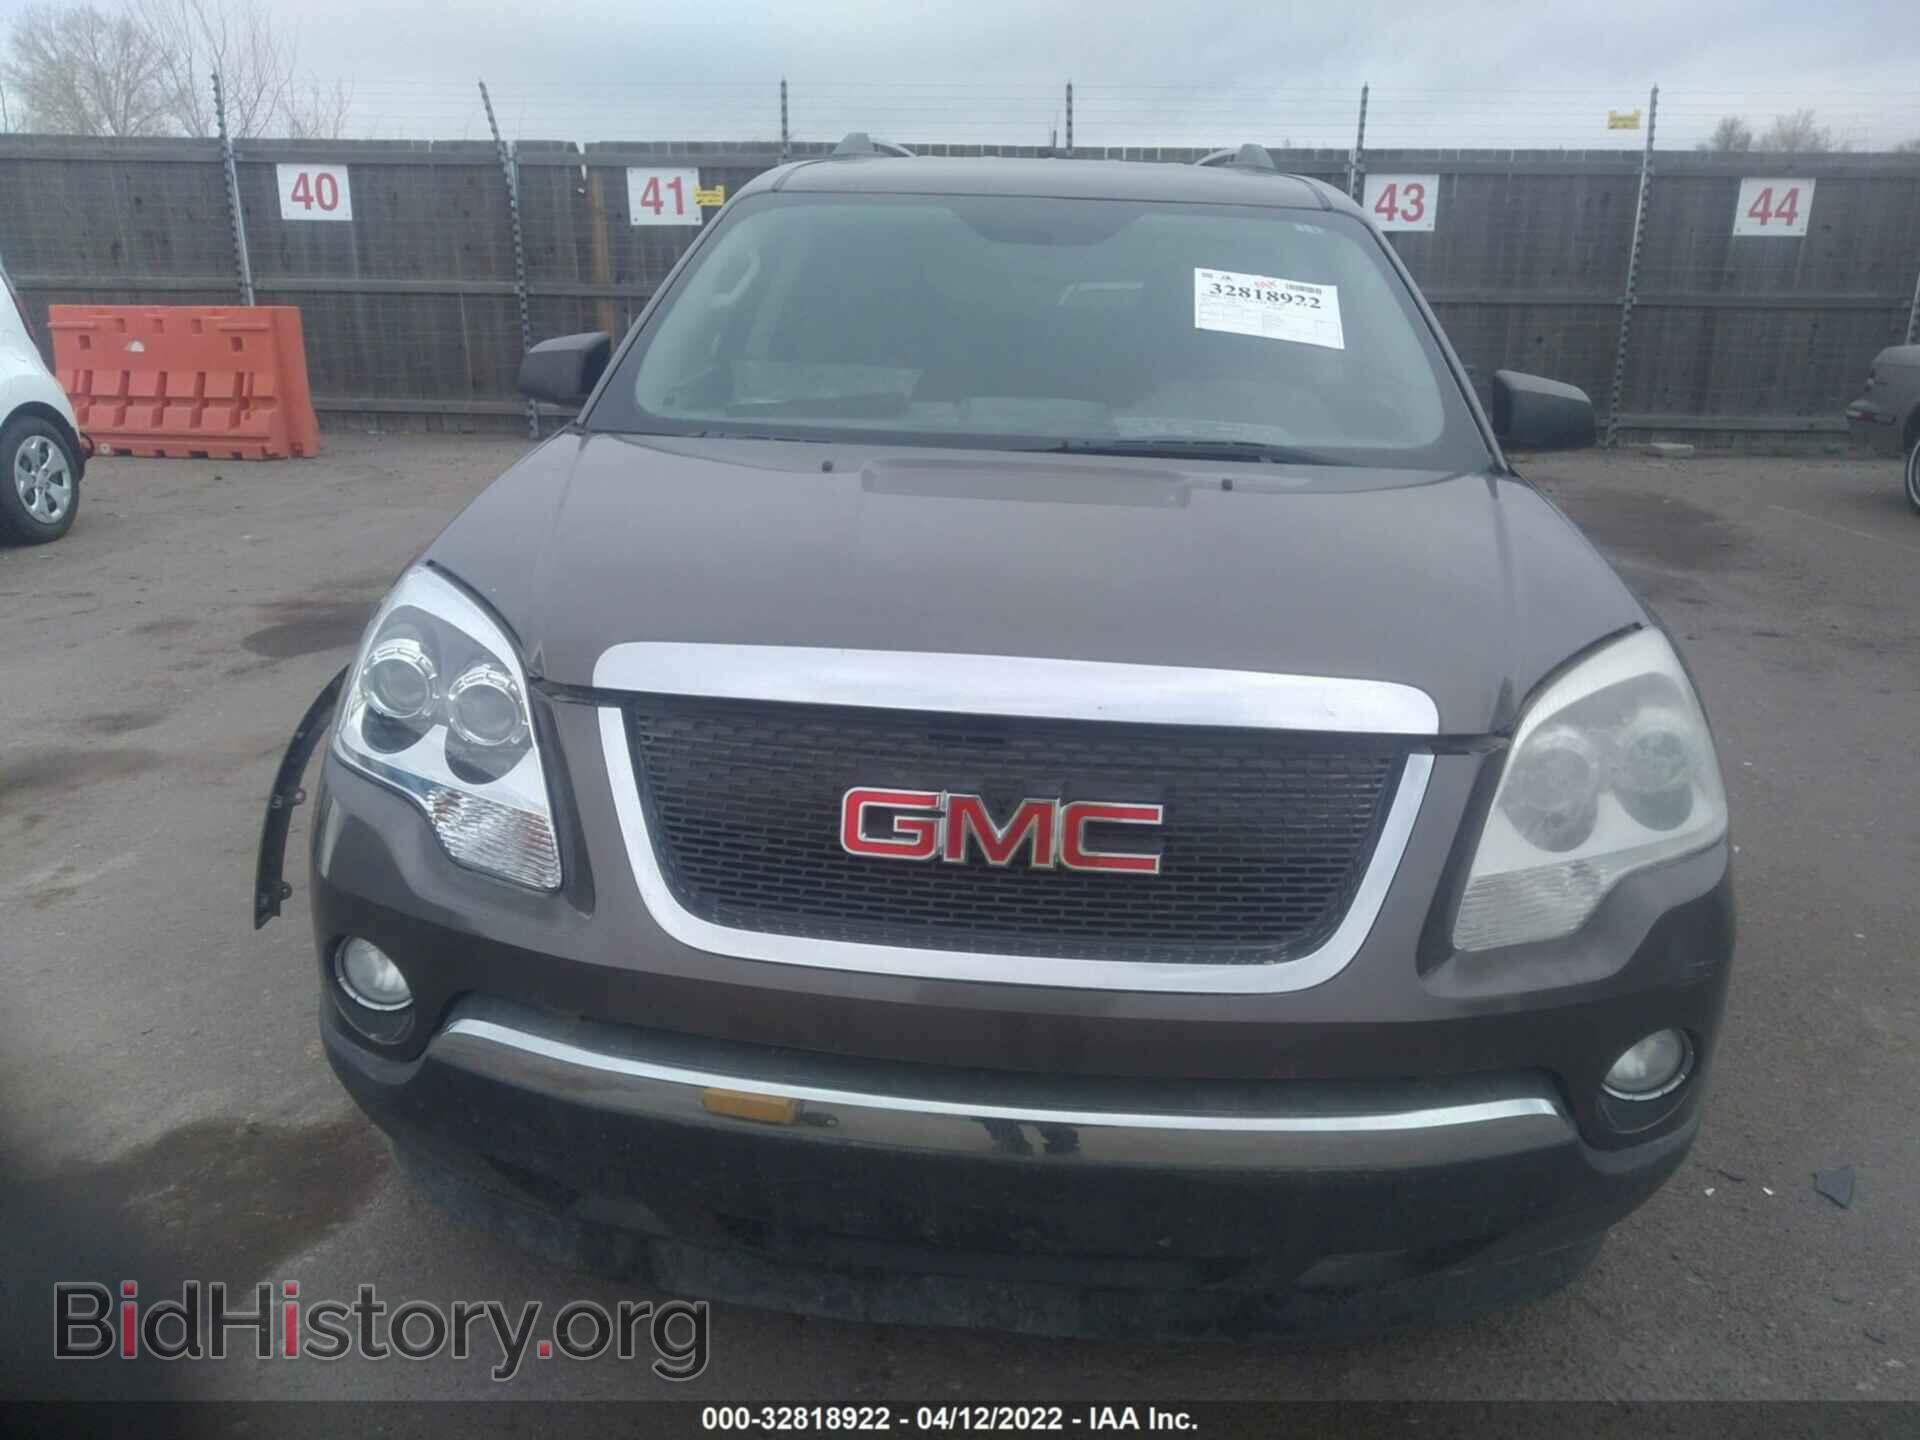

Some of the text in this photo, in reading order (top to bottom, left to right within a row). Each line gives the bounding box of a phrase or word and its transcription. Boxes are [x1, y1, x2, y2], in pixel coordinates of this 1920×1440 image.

[291, 172, 338, 211] 40
[640, 176, 684, 215] 41
[1375, 183, 1424, 222] 43
[1748, 187, 1799, 226] 44
[1209, 283, 1321, 309] 32818922
[840, 786, 1164, 875] GMC
